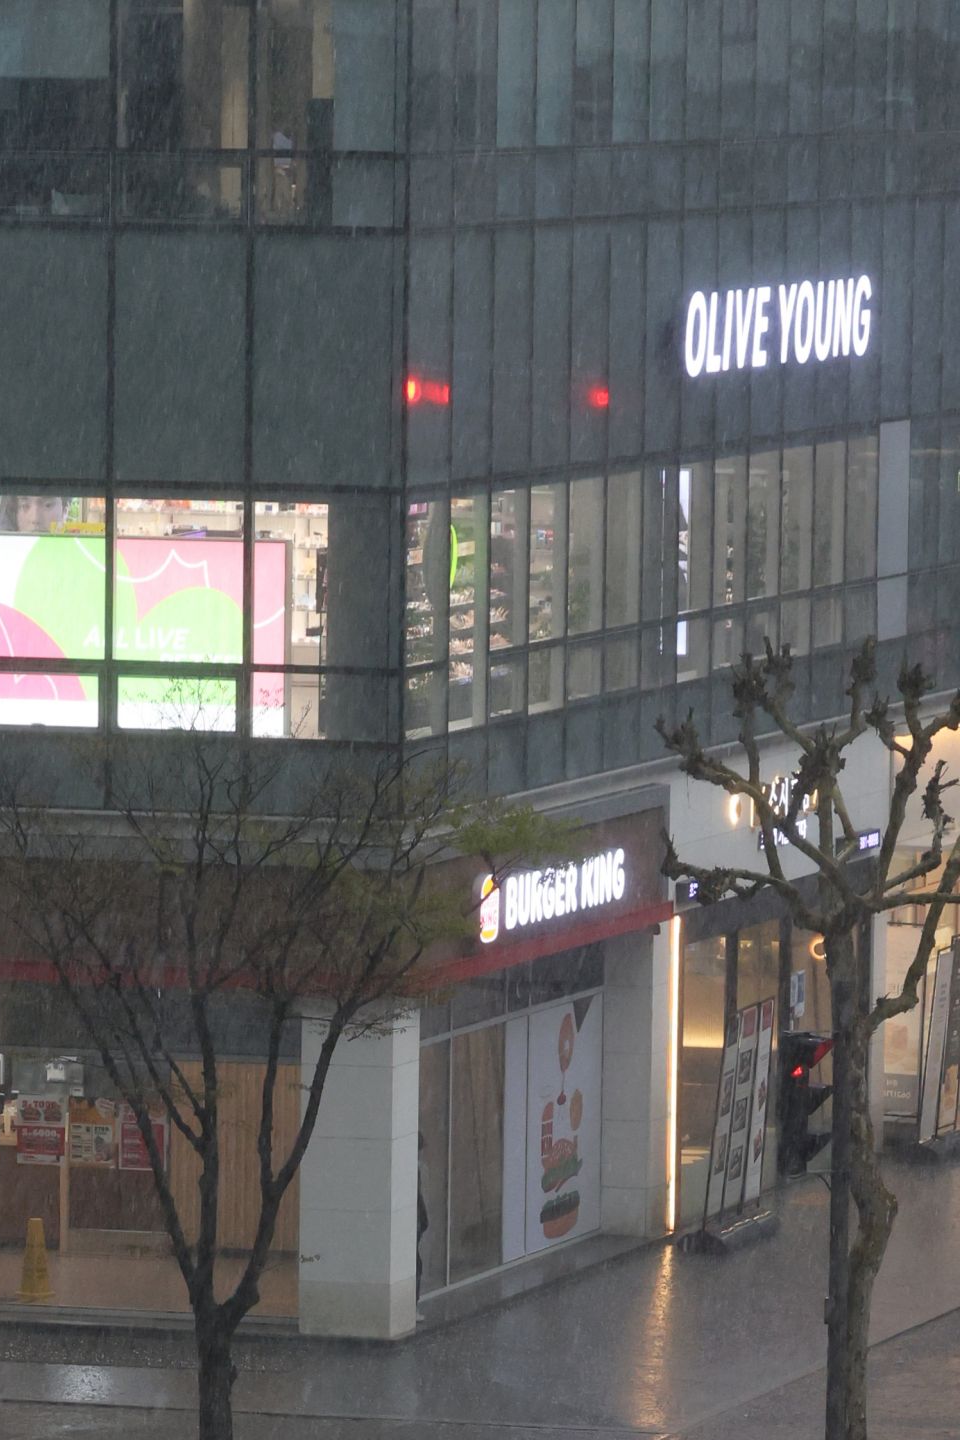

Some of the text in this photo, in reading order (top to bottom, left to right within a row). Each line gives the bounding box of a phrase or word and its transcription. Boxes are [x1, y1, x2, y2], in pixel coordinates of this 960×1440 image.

[685, 274, 872, 377] OLIVE YOUNG
[505, 848, 625, 930] BURGER KING
